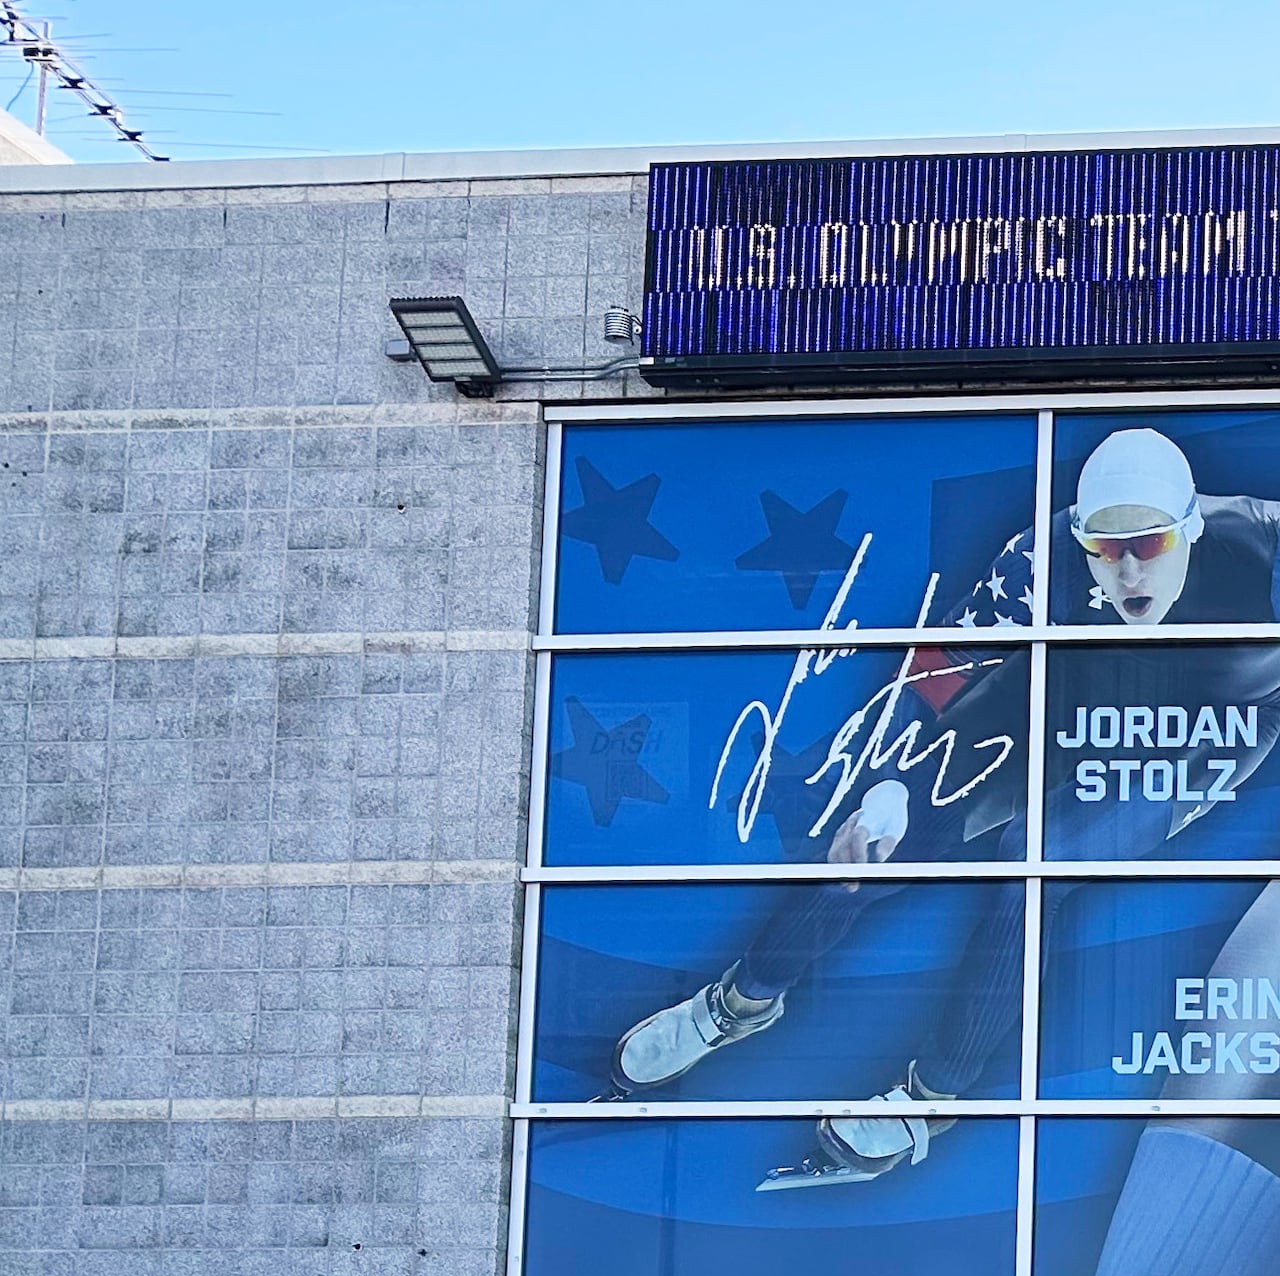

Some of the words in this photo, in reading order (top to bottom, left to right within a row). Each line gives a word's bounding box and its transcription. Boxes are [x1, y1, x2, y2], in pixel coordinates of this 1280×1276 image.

[820, 213, 1068, 288] OLYMPIC
[1092, 209, 1247, 281] TEAM
[1056, 705, 1258, 748] JORDAN
[1075, 759, 1237, 802] STOLZ
